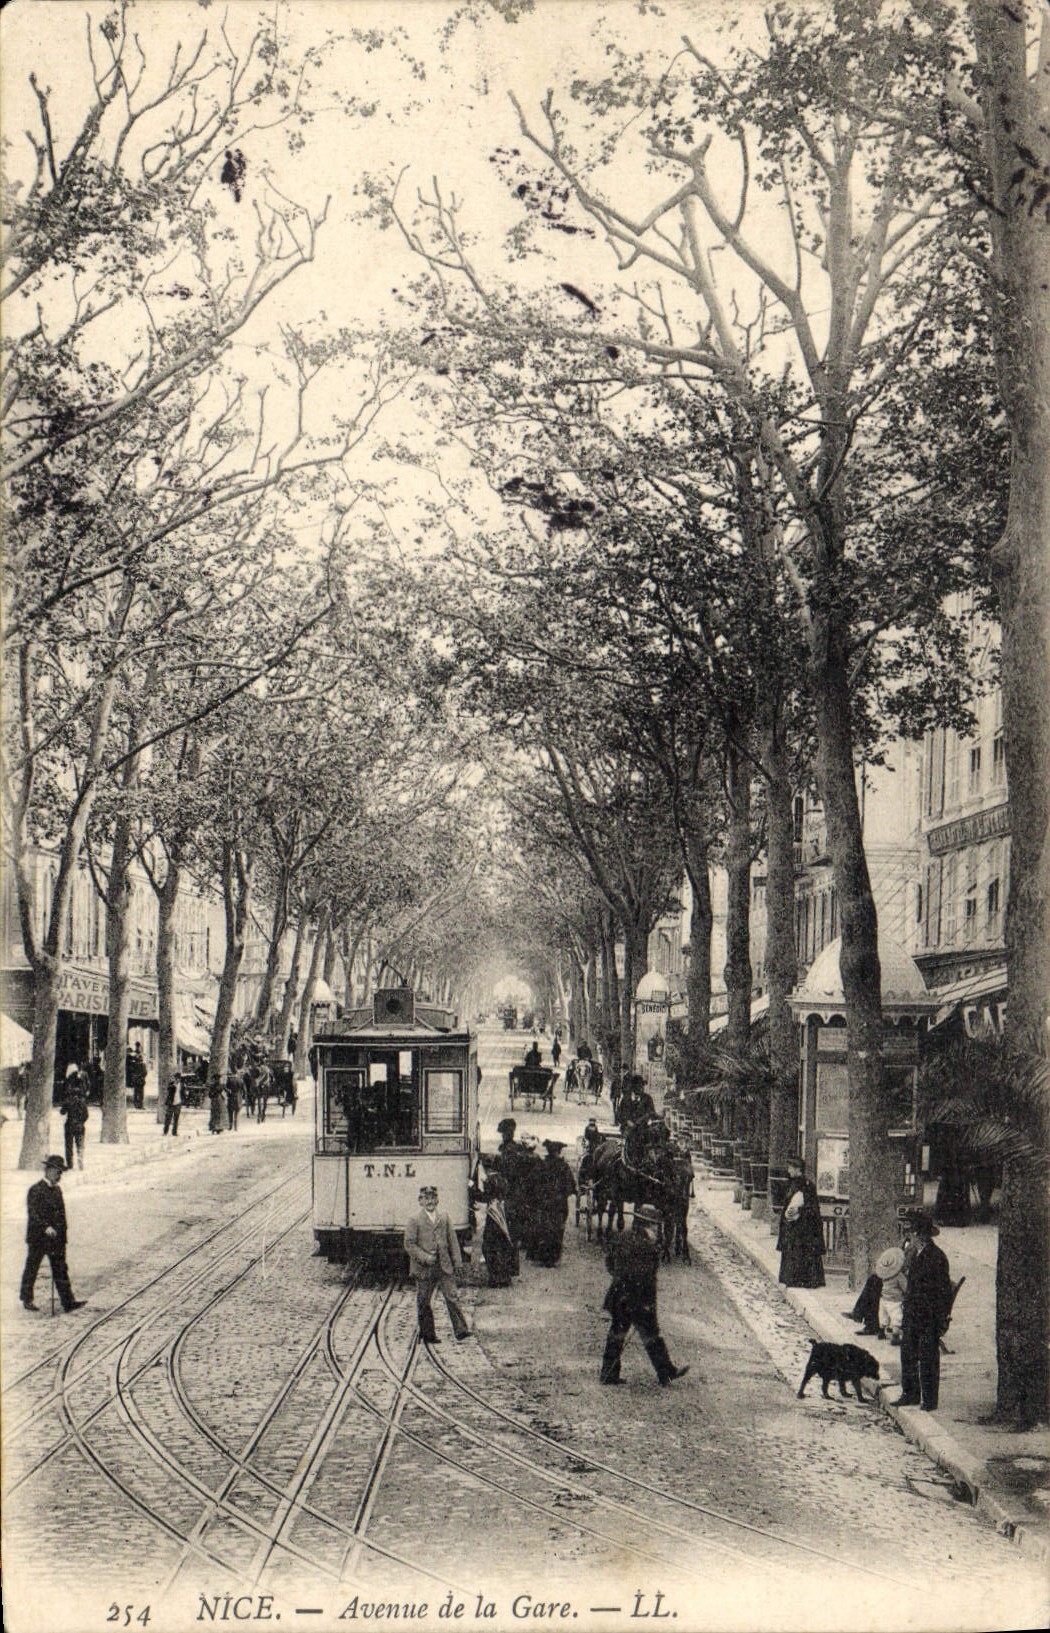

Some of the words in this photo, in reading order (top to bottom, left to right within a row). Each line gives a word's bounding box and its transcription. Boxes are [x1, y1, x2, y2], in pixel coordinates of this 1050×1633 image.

[60, 973, 110, 993] TAVER
[58, 990, 151, 1017] PARISINE
[963, 1001, 1008, 1040] CAF
